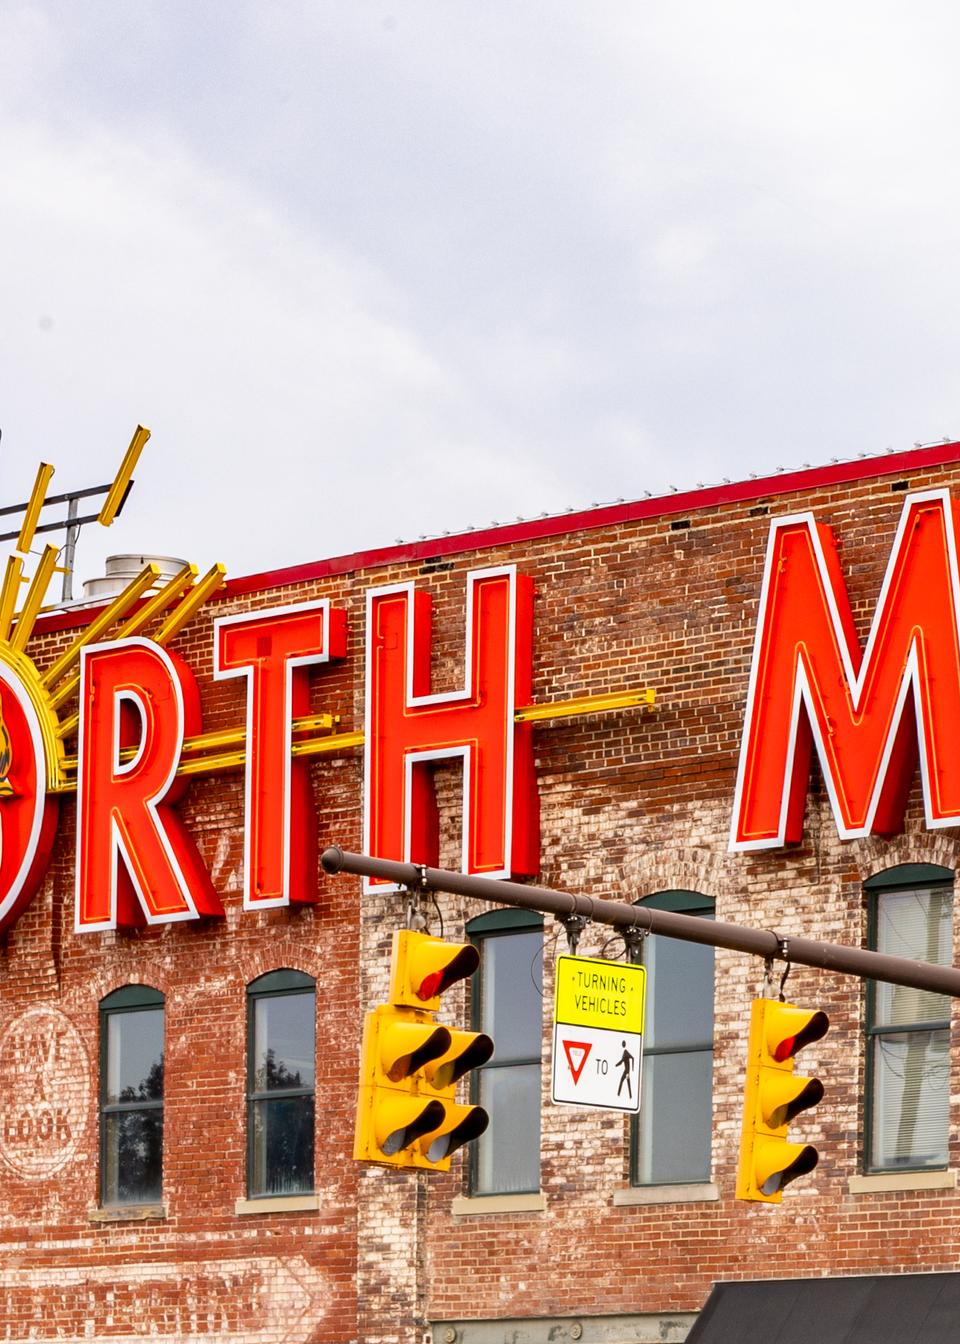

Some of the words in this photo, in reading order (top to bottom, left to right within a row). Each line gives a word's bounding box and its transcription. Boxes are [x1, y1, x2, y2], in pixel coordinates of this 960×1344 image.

[577, 971, 626, 993] TURNING
[574, 995, 627, 1017] VEHICLES
[595, 1058, 608, 1075] TO
